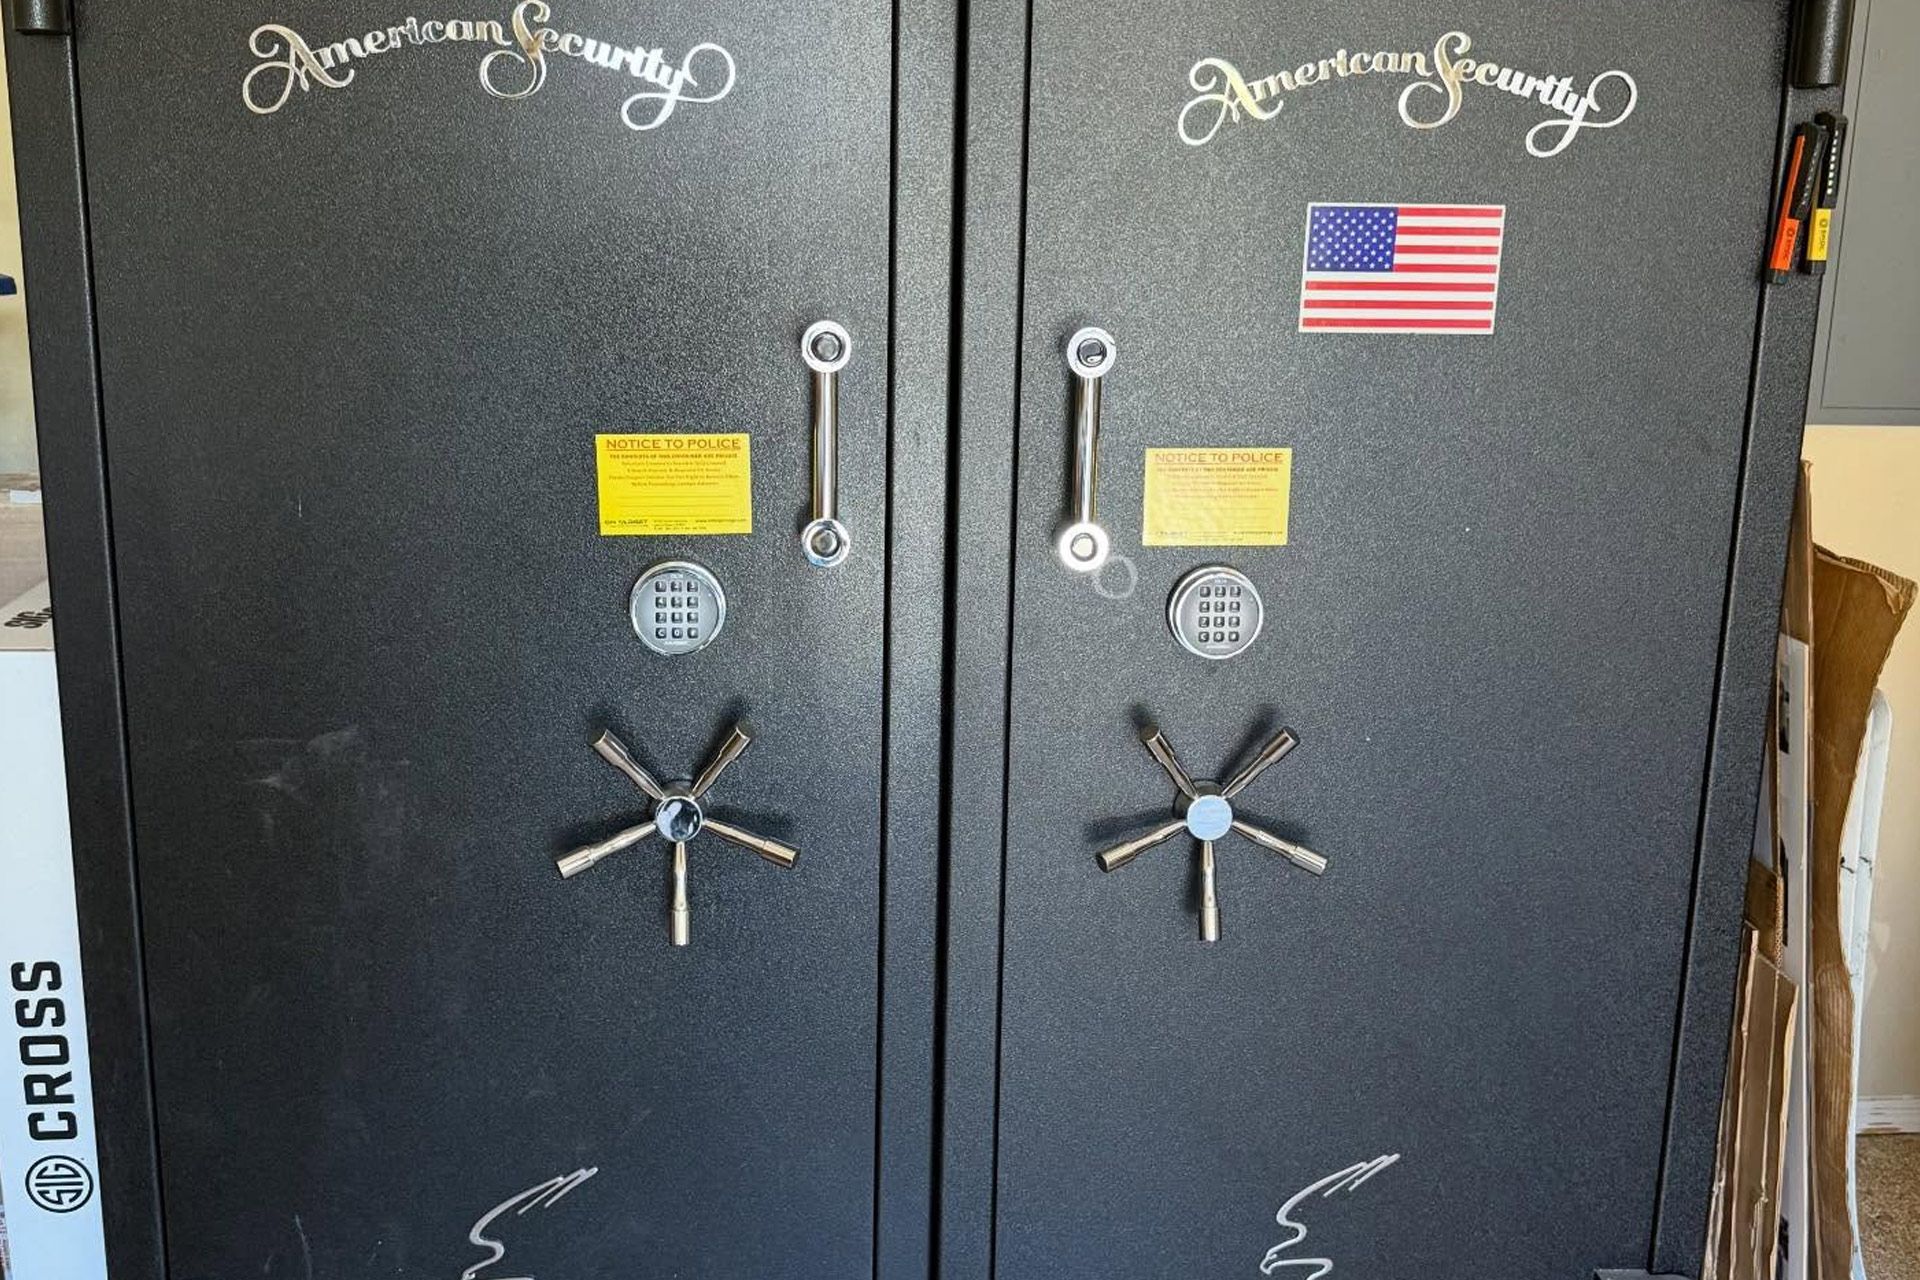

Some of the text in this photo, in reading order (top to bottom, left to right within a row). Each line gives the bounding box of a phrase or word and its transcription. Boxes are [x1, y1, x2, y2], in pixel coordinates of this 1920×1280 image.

[243, 0, 736, 131] American Security
[1177, 31, 1638, 158] American Security
[606, 438, 741, 449] NOTICE TO POLICE
[1154, 452, 1284, 463] NOTICE TO POLICE
[11, 961, 78, 1141] CROSS
